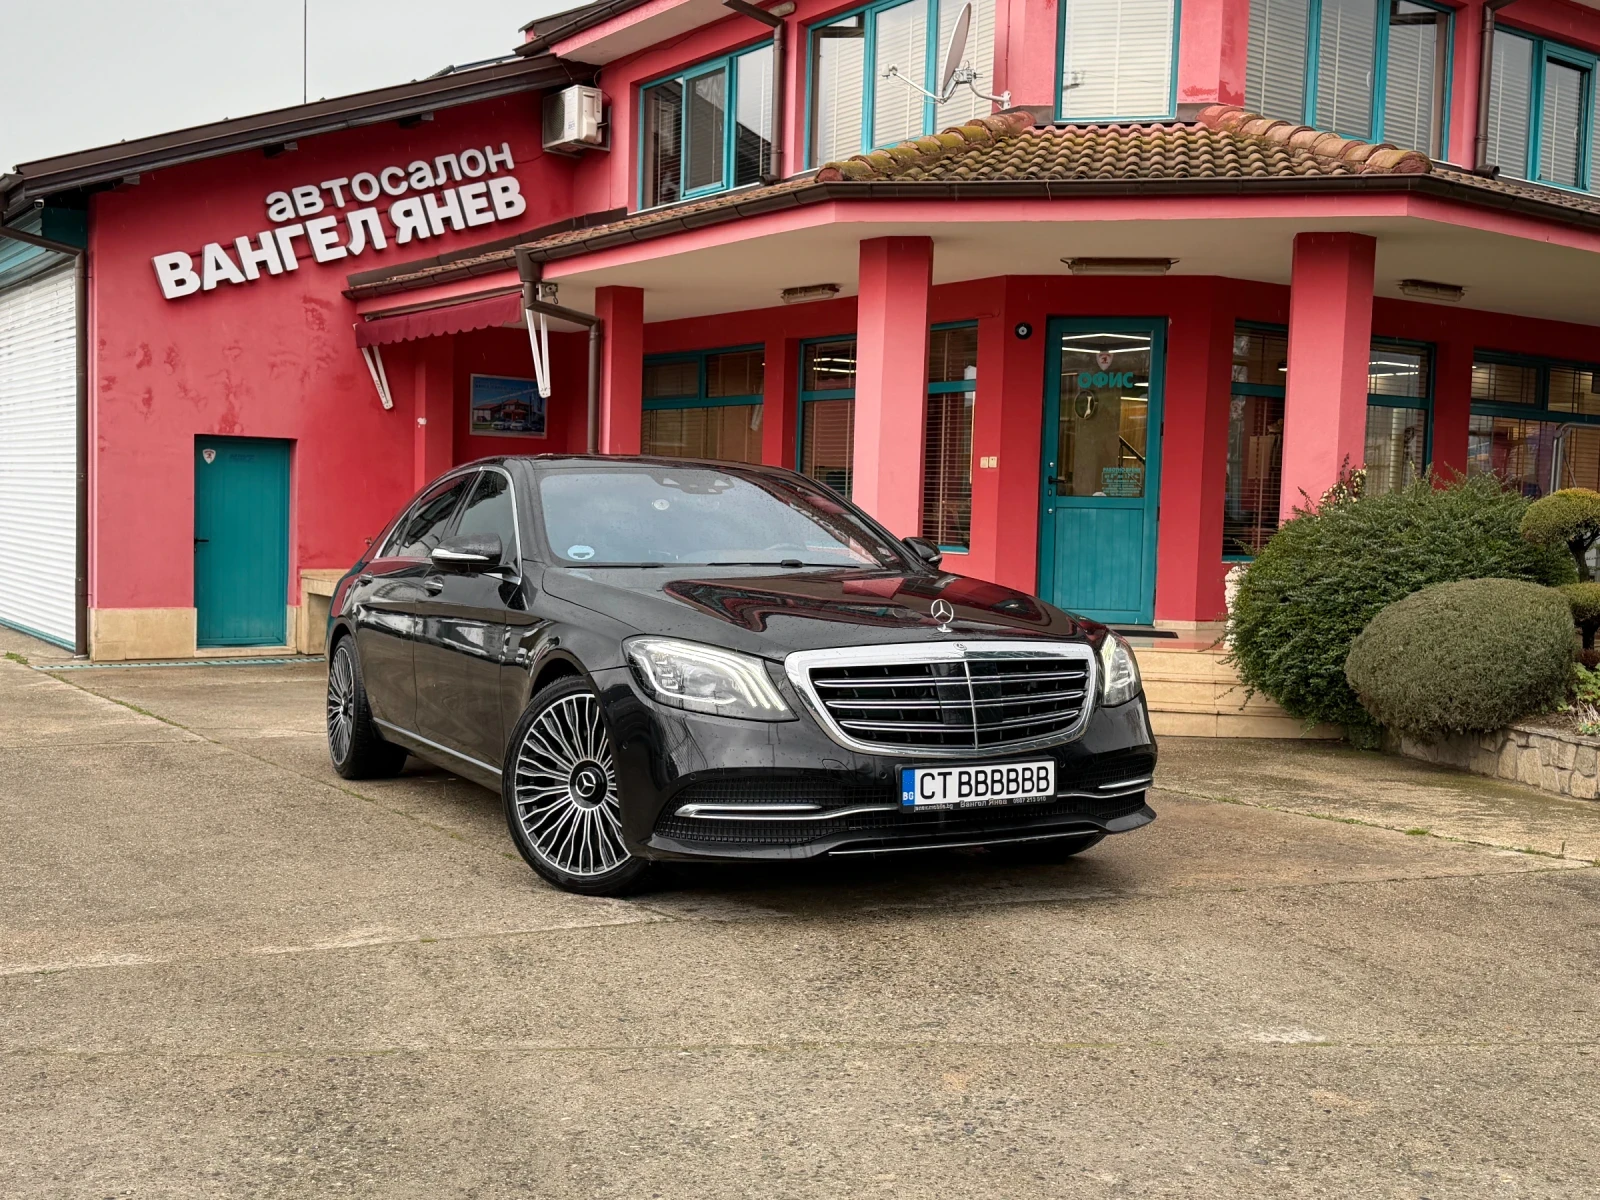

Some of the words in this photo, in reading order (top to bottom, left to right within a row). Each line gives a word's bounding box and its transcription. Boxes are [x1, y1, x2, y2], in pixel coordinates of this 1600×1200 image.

[151, 206, 388, 300] ВАНГЕЛ
[388, 175, 527, 244] ЯНЕВ
[1077, 371, 1134, 389] ОФИС
[902, 791, 914, 801] BG
